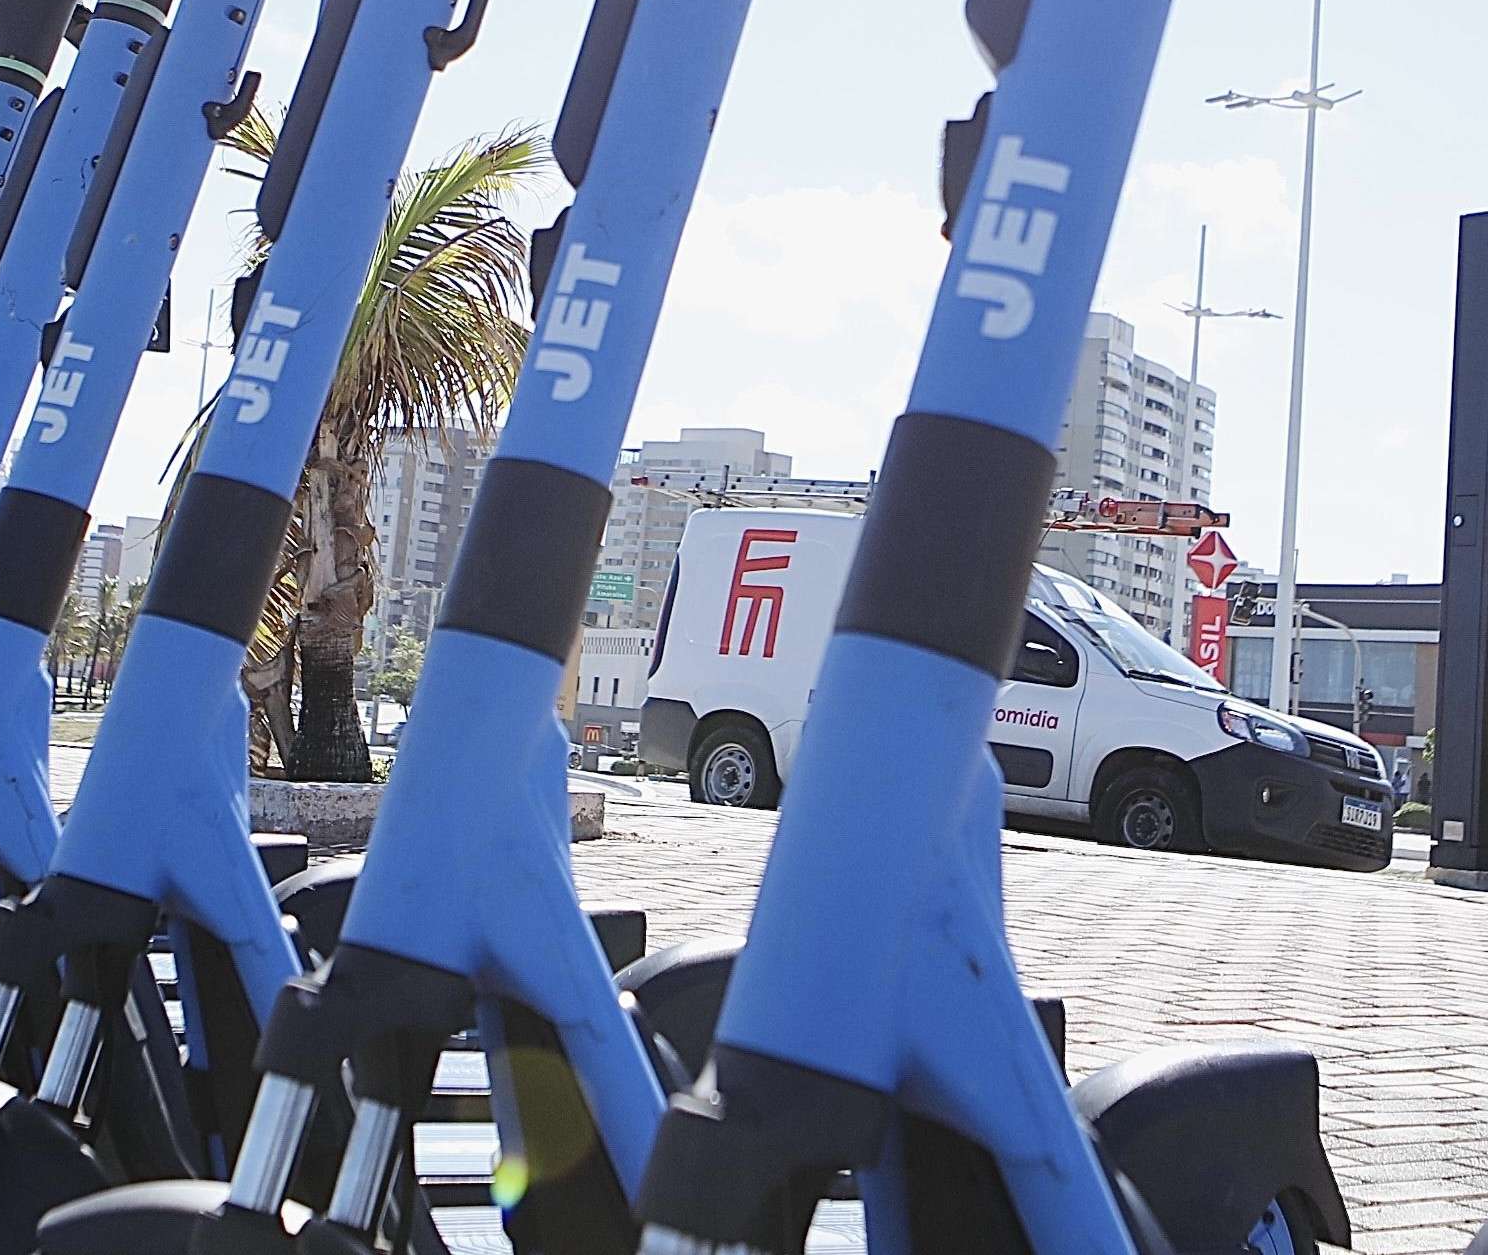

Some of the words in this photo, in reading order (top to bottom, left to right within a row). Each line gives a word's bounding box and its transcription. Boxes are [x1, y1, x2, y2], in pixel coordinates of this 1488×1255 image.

[957, 134, 1071, 340] JET
[33, 331, 95, 444] JET
[226, 291, 302, 424] JET
[534, 243, 623, 402] JET
[993, 707, 1059, 729] omidia
